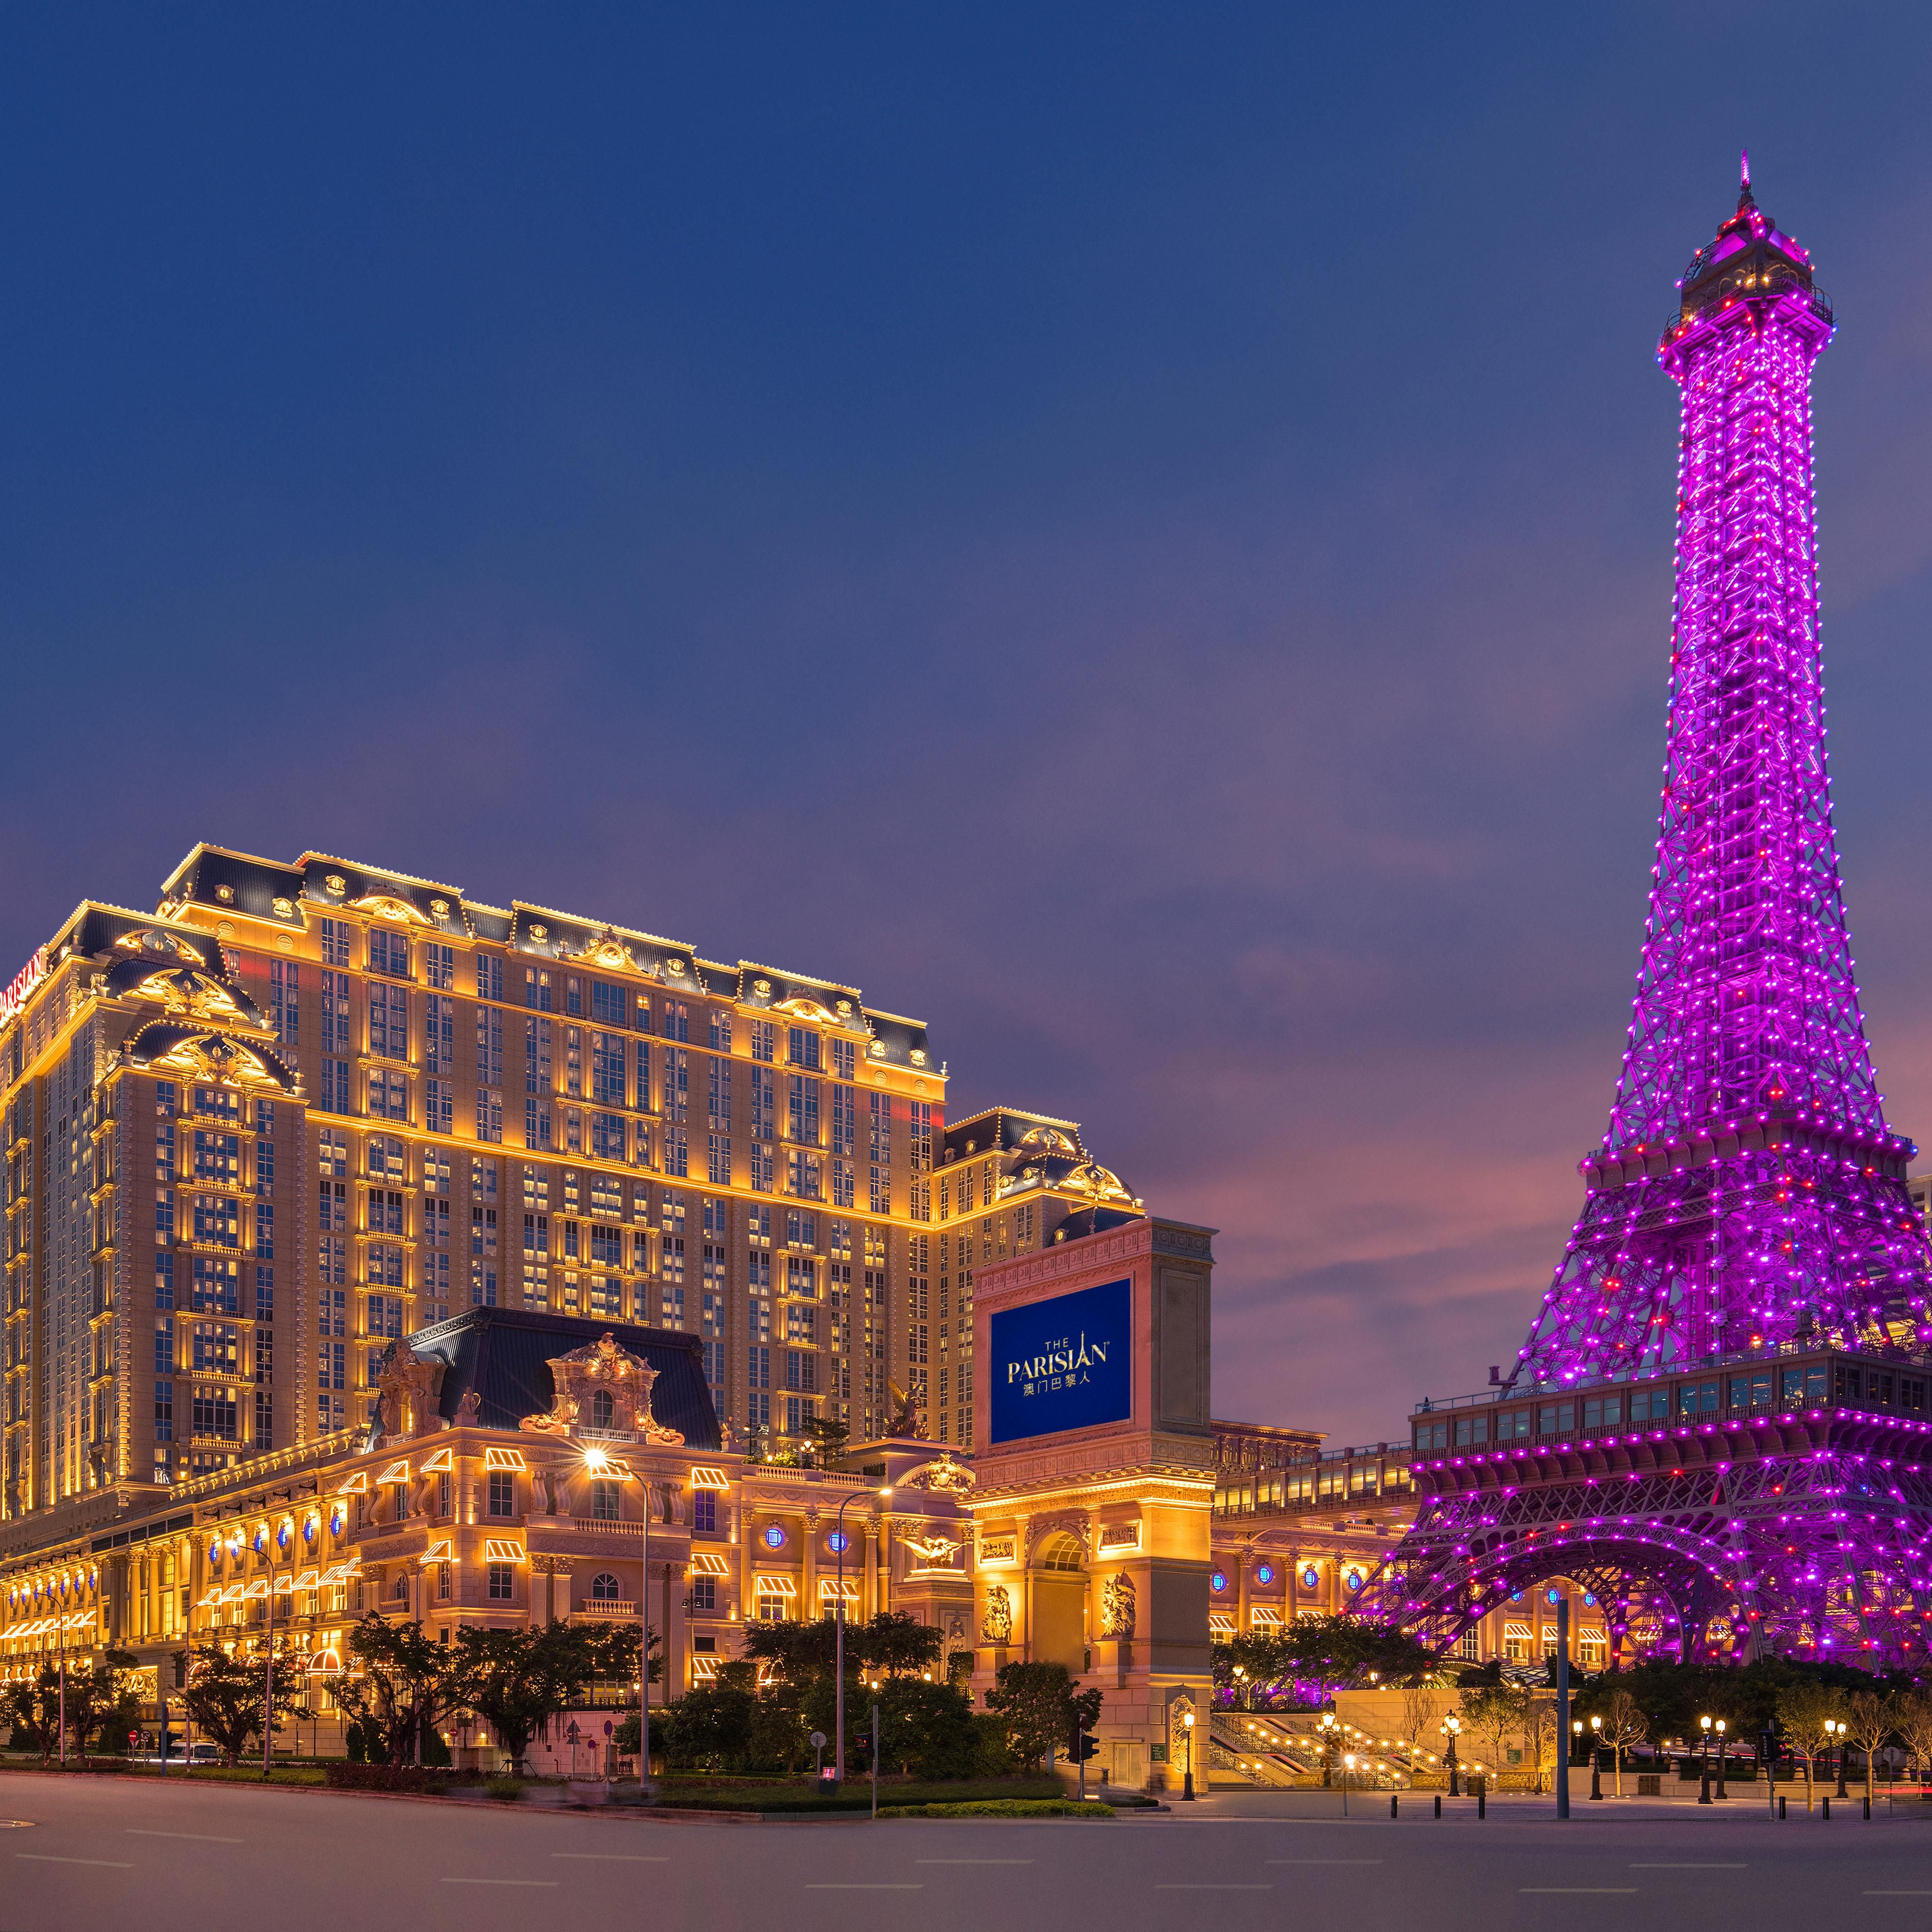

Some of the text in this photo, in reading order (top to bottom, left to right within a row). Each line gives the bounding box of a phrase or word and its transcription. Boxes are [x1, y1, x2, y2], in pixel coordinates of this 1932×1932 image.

[0, 947, 42, 1016] ARISIAN
[1008, 1331, 1107, 1383] PARISIAN
[1045, 1338, 1069, 1351] THE
[1023, 1371, 1090, 1396] 澳门巴黎人
